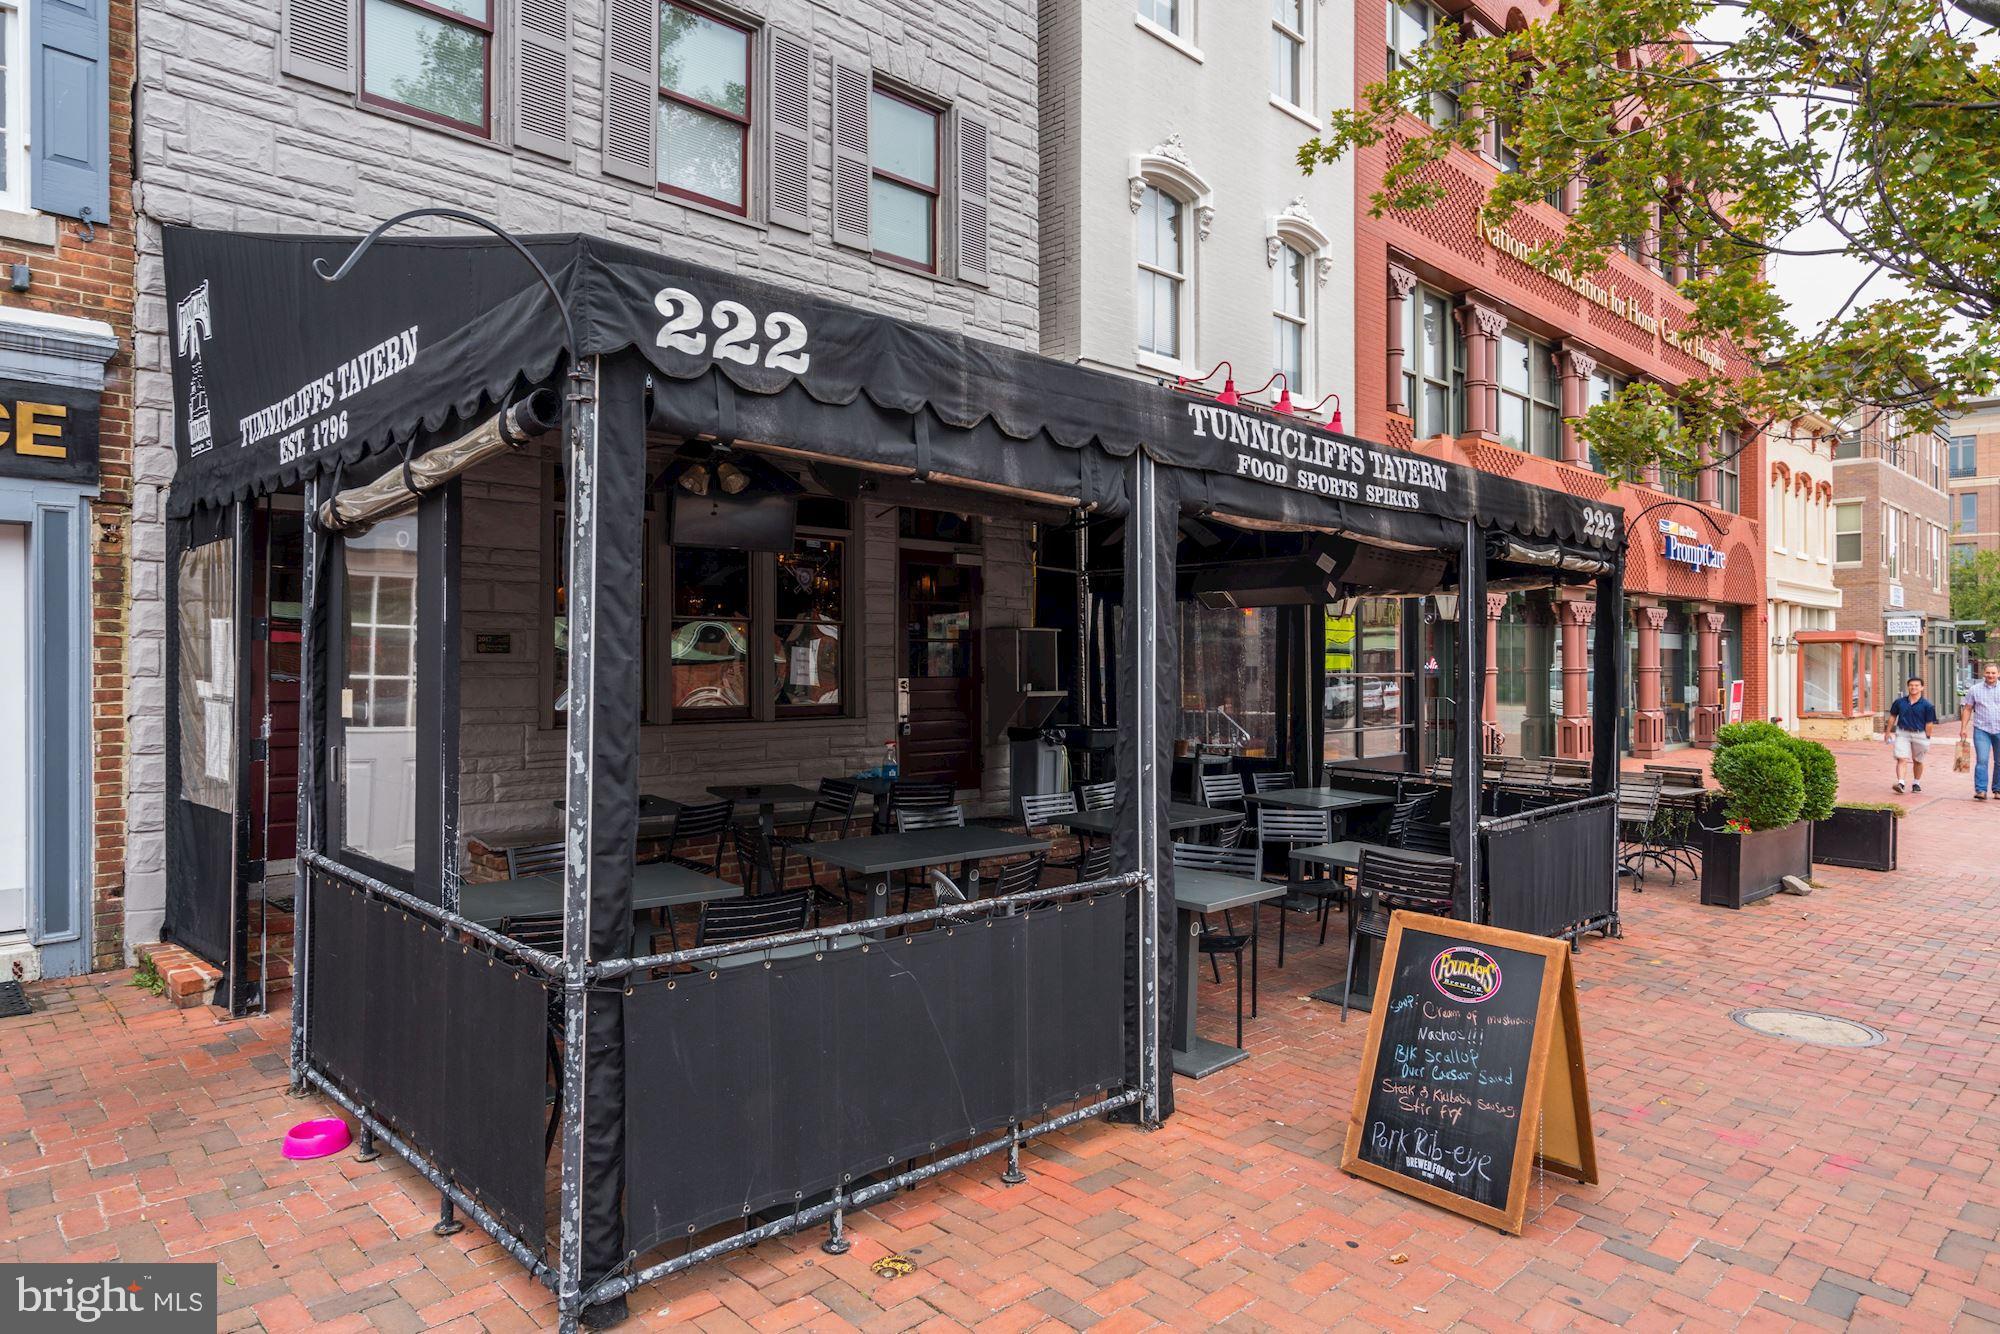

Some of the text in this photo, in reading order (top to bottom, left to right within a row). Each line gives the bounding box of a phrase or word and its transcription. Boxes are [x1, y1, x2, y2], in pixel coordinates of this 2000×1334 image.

[654, 287, 810, 375] 222
[1610, 284, 1626, 317] for
[1626, 296, 1659, 336] Home
[1694, 335, 1726, 374] Hospice
[239, 325, 418, 448] TUNNICLIFFS TAVERN
[0, 400, 66, 458] E
[279, 410, 348, 465] EST. 1796
[1187, 402, 1447, 492] TUNNICLIFFS TAVERN
[1236, 453, 1419, 510] FOOD SPORTS SPIRITS
[1583, 506, 1616, 540] 222
[1669, 535, 1726, 573] PromptCare
[1438, 953, 1497, 993] Founders
[1422, 1001, 1460, 1019] Cream
[1466, 1010, 1478, 1026] of
[1382, 1078, 1416, 1095] Steak
[1431, 1065, 1472, 1081] Caesar
[1398, 1096, 1432, 1115] Stir
[1371, 1121, 1492, 1182] Pork Rib-eye
[1405, 1156, 1432, 1172] BREWED
[1432, 1162, 1446, 1178] FOR
